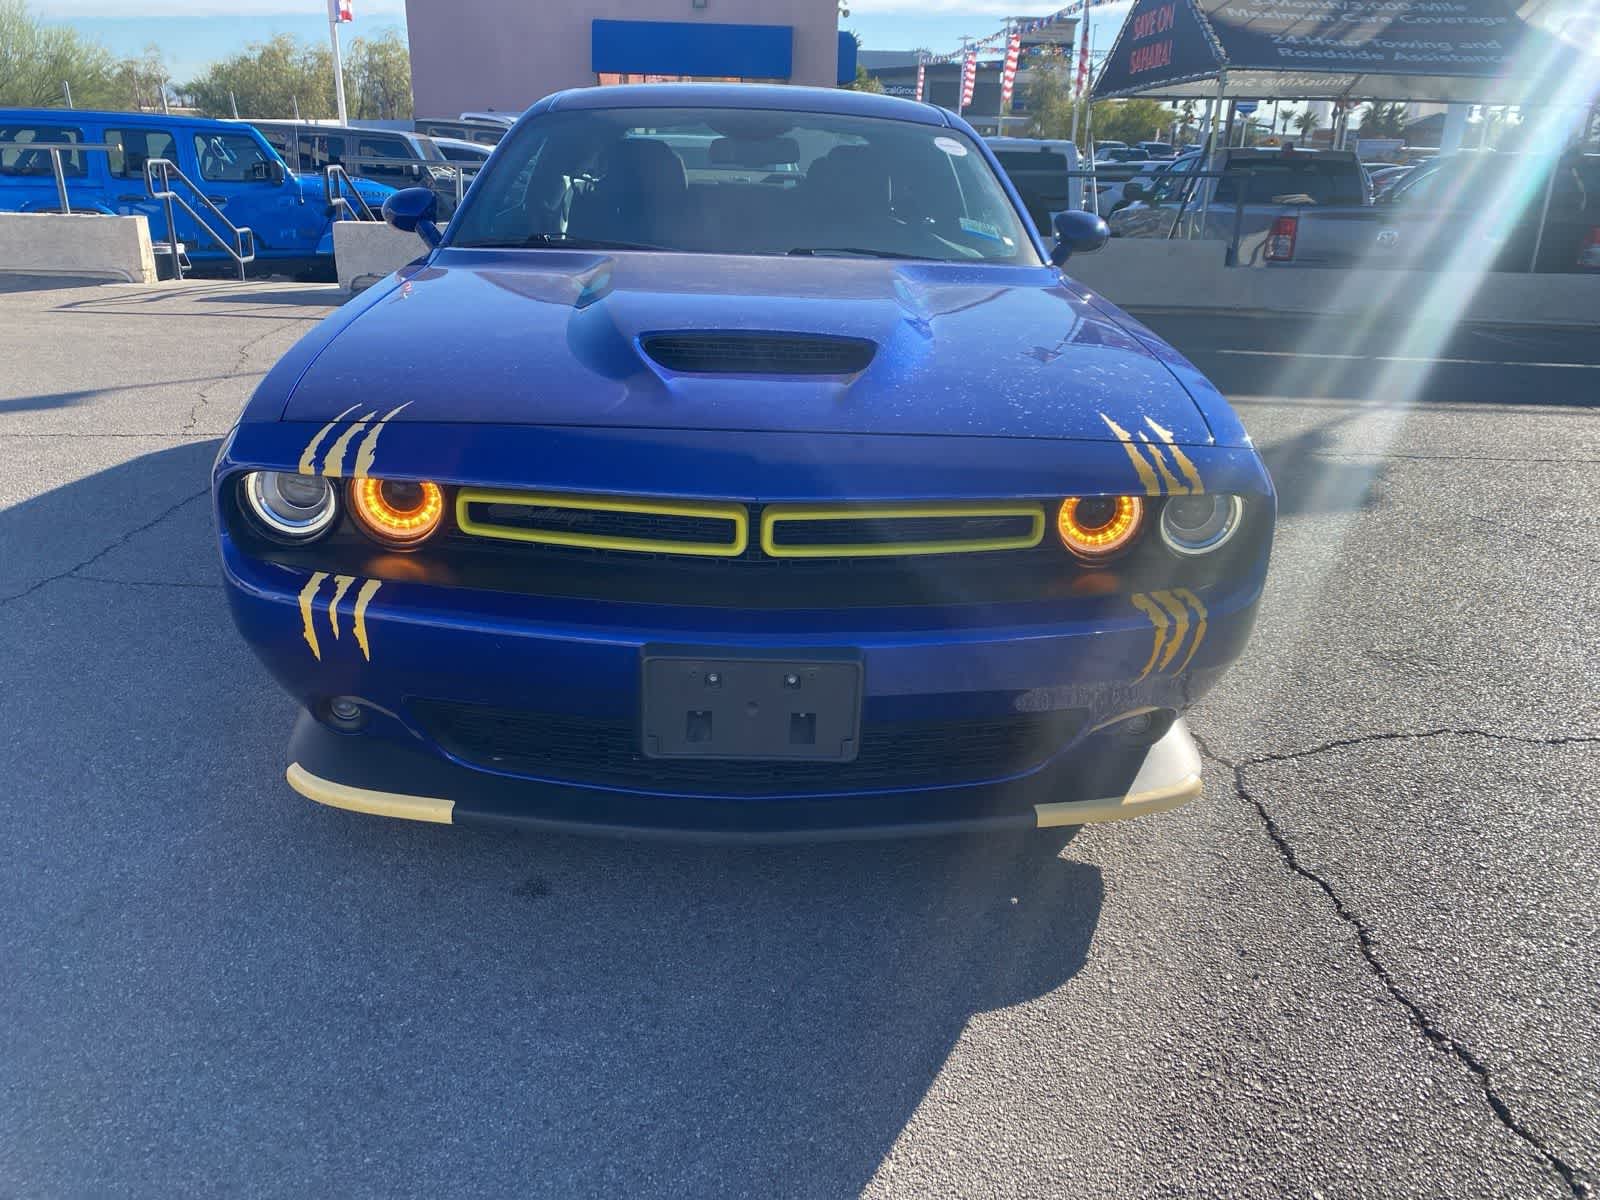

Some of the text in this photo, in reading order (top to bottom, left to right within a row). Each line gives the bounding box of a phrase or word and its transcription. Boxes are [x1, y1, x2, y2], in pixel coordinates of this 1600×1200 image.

[1133, 4, 1176, 40] SAVE ON
[1226, 7, 1509, 26] Maximum Care Coverage
[1270, 33, 1503, 50] 24-Hour Towing and
[1129, 41, 1173, 74] SAHARA!
[1278, 47, 1385, 60] Roadside
